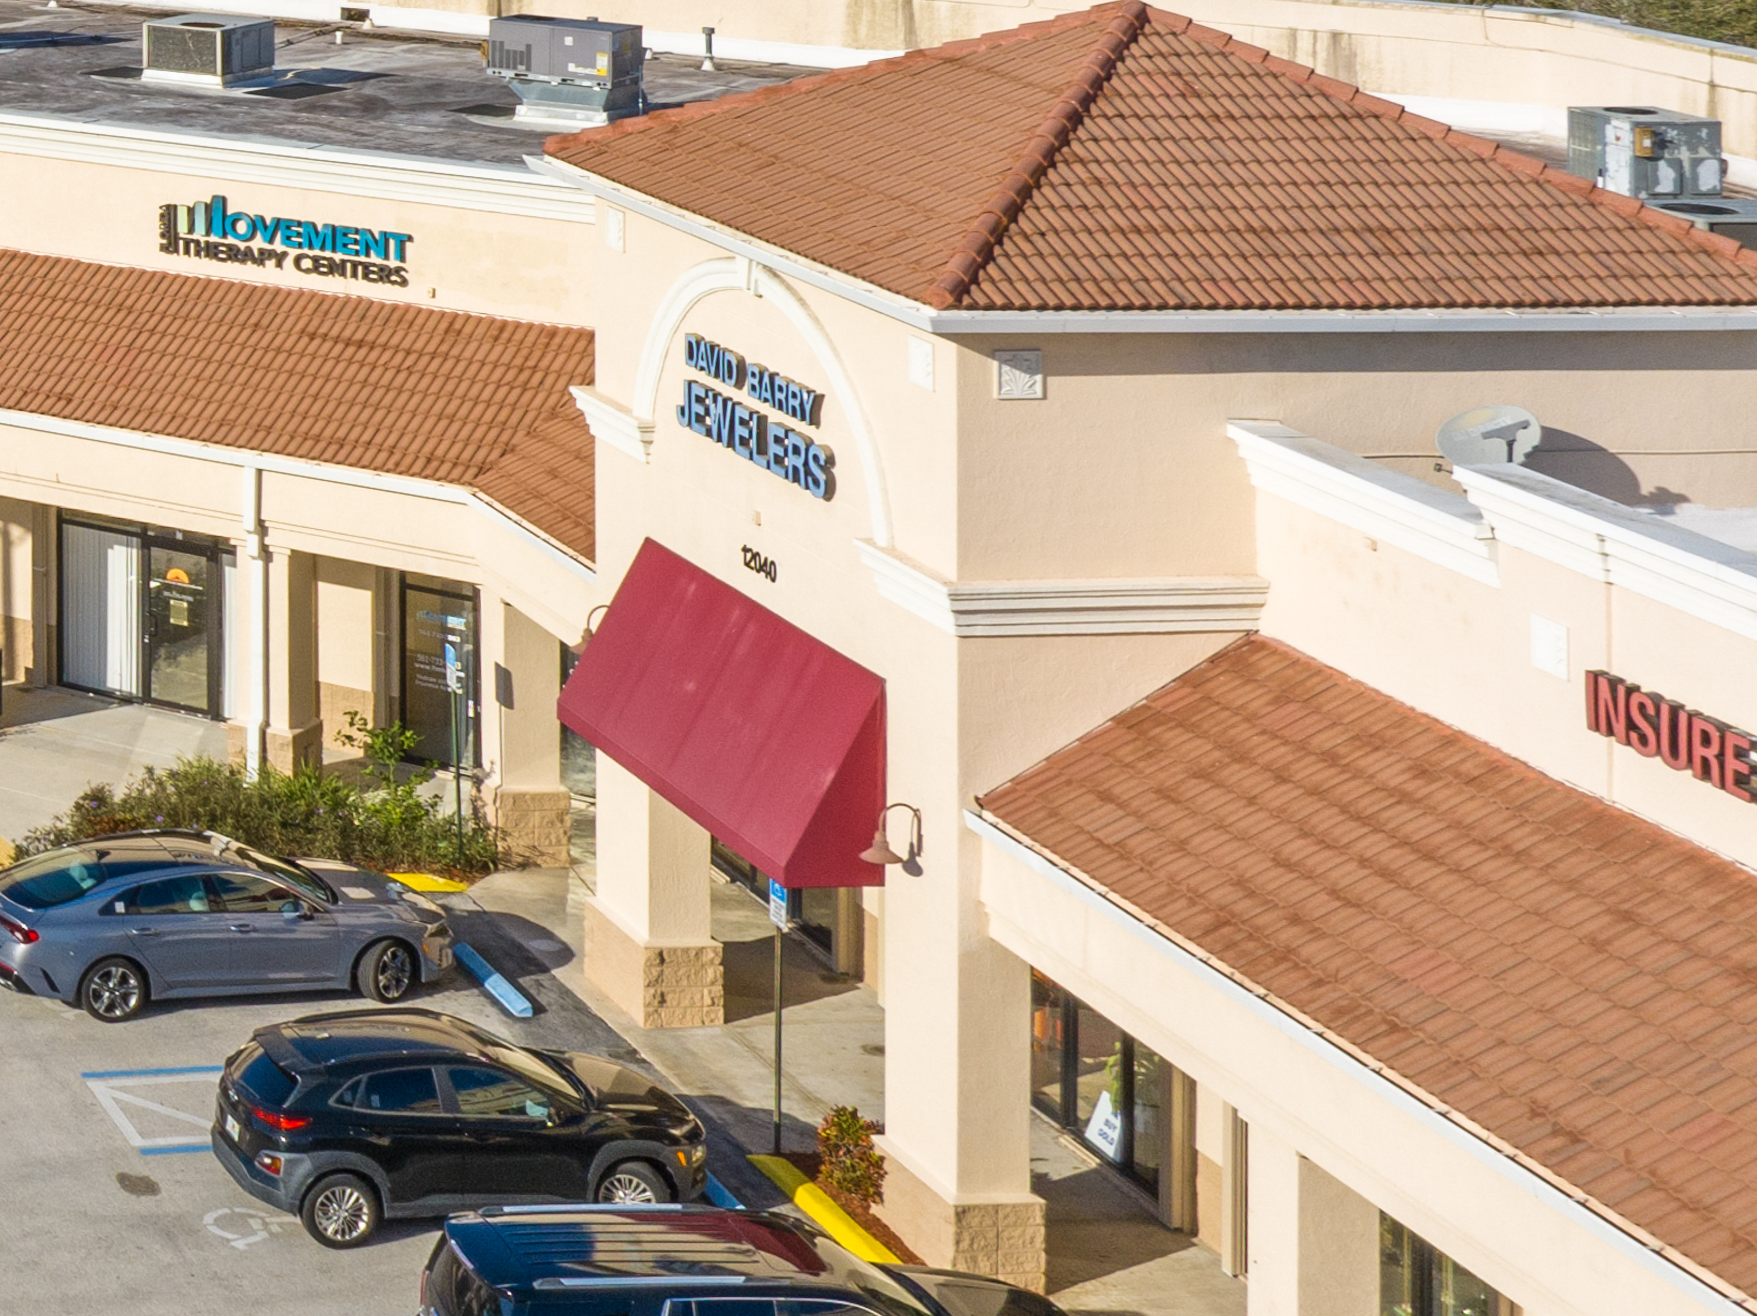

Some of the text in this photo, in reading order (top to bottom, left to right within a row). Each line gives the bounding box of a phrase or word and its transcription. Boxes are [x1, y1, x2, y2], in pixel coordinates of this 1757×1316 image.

[176, 237, 410, 288] THERAPY CENTERS
[684, 333, 820, 427] DAVID BARRY
[676, 378, 830, 501] JEWELERS
[741, 543, 777, 583] 12040
[1584, 669, 1753, 804] INSURE
[1097, 1128, 1115, 1146] GOLD
